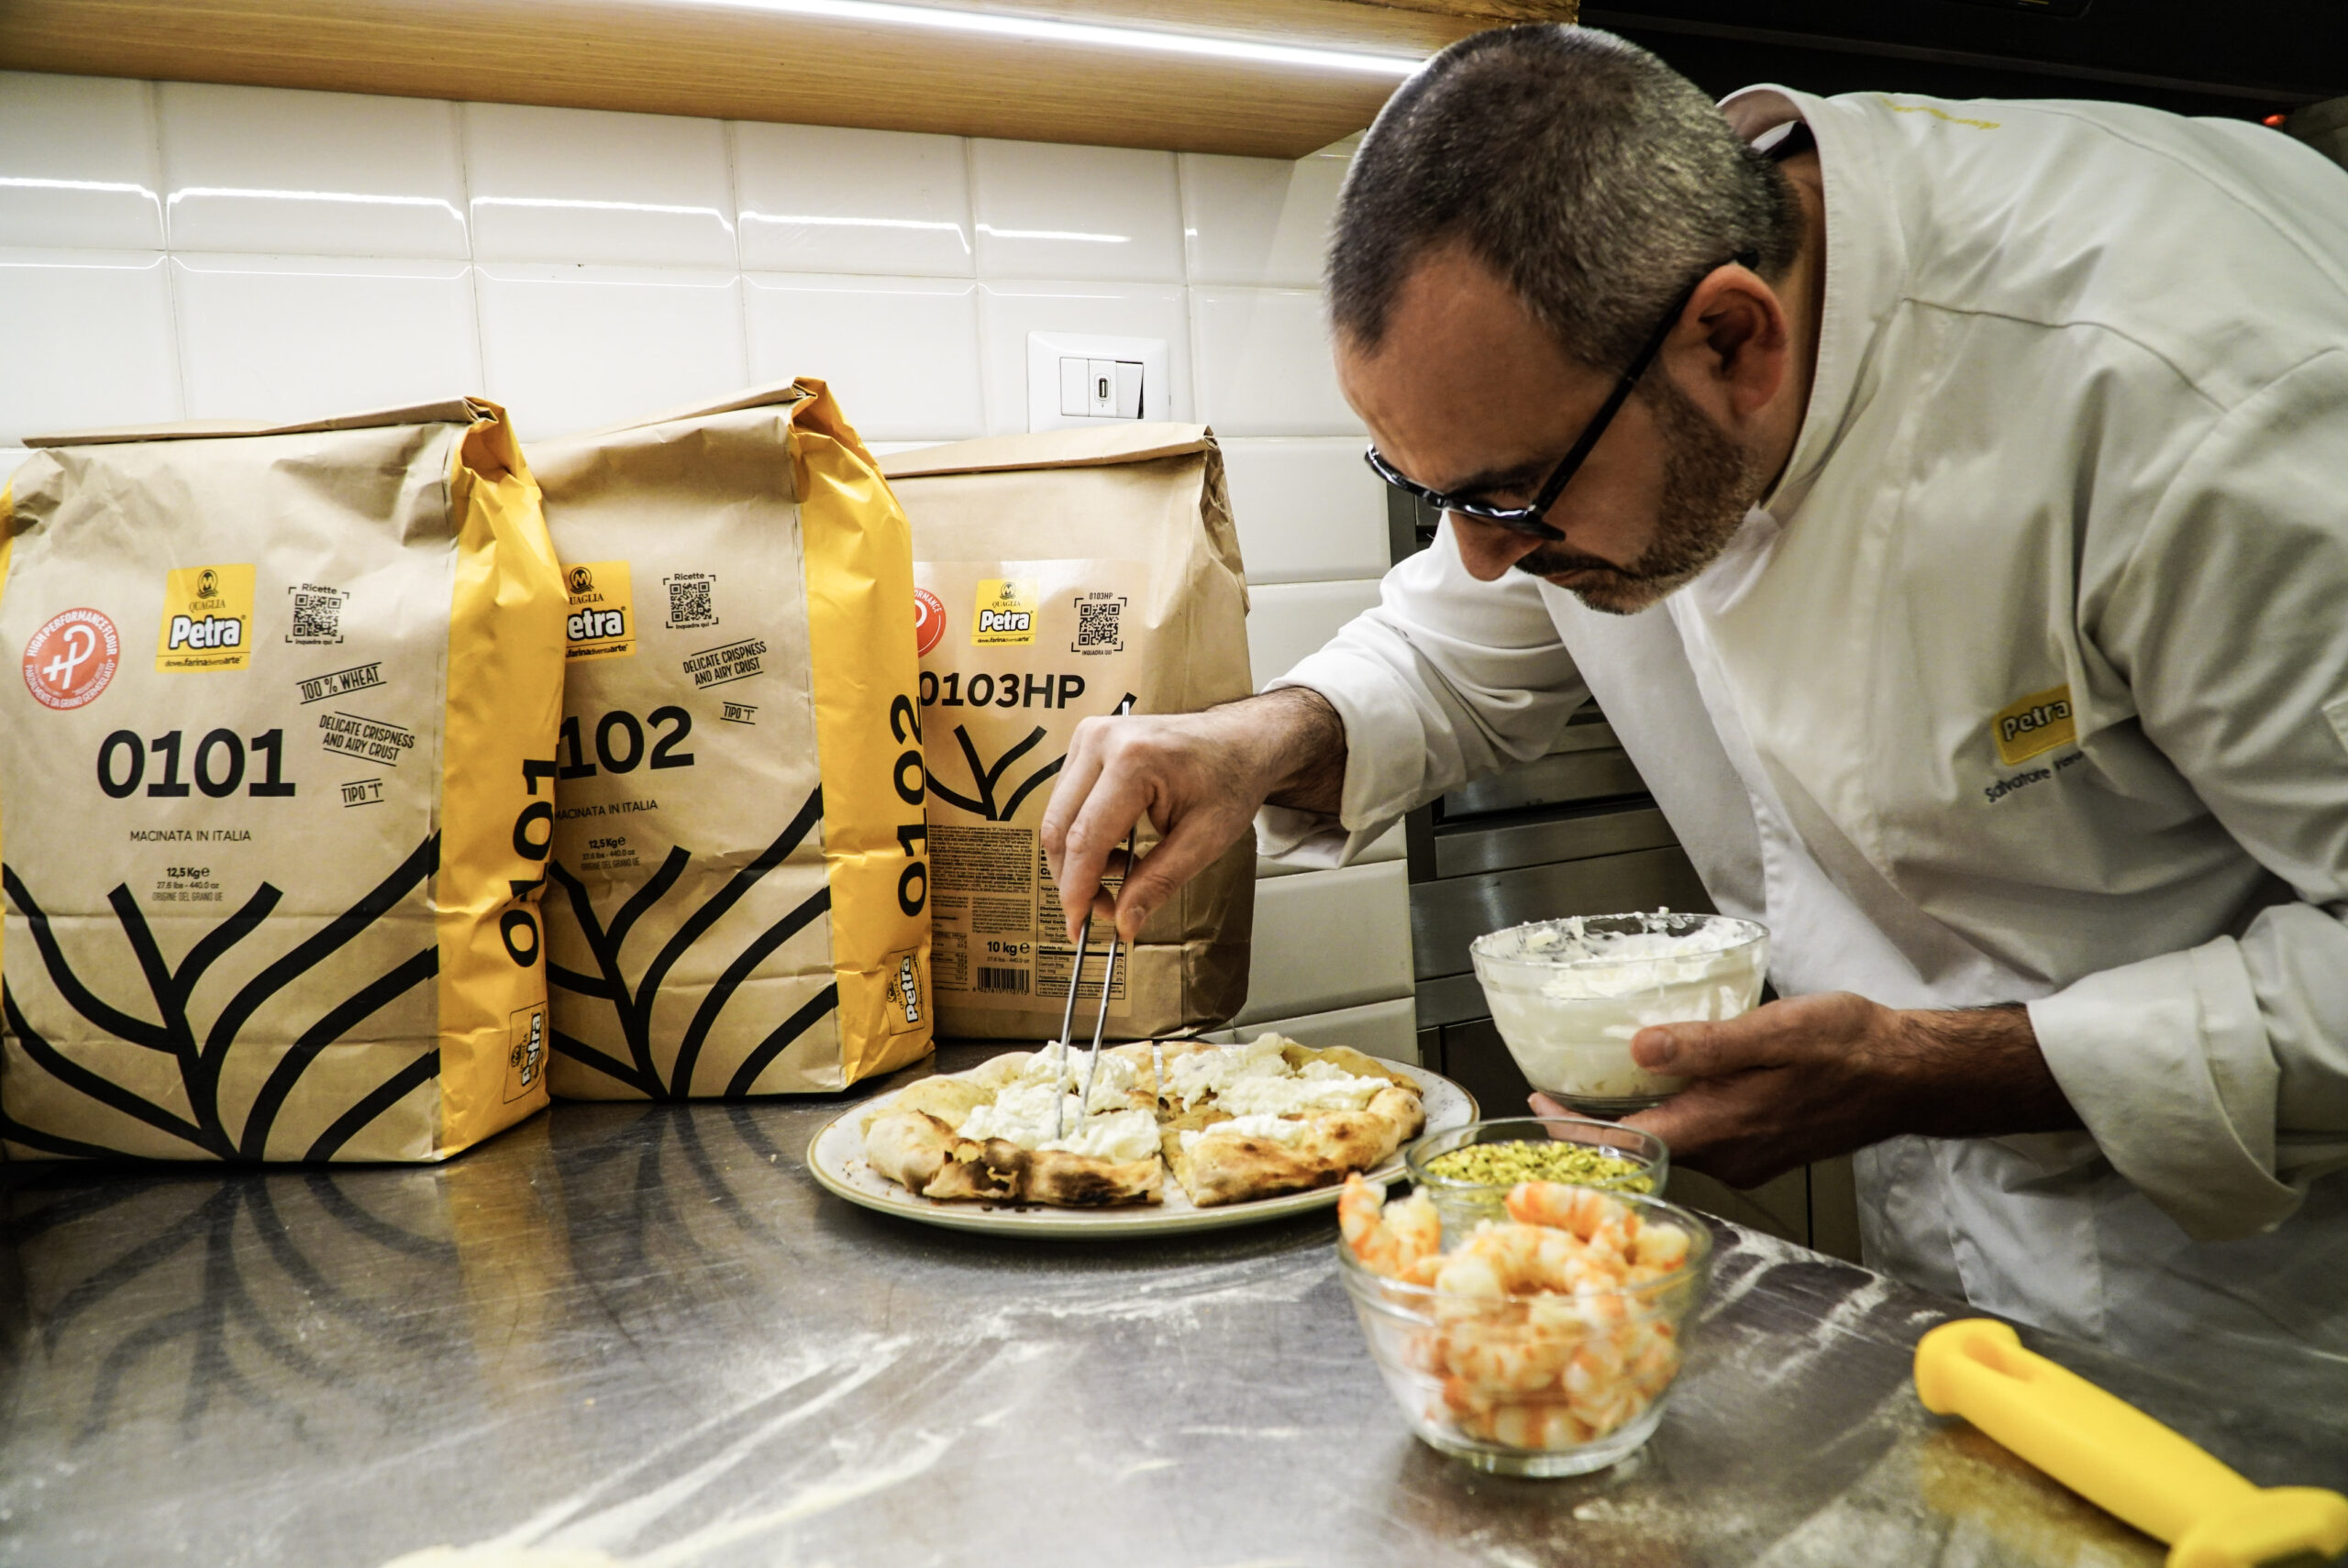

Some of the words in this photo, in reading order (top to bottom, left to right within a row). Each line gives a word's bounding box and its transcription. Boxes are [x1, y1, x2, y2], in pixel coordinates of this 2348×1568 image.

[302, 583, 338, 594] Ricette
[674, 573, 705, 581] Ricette
[189, 600, 227, 613] QUAGLIA
[570, 593, 604, 605] UAGLIA
[914, 590, 943, 613] ORMANCE
[992, 601, 1021, 609] QUAGLIA
[1089, 592, 1113, 601] 0103HP
[26, 633, 47, 657] HIGH
[42, 610, 109, 636] PERFORMANCE
[102, 624, 118, 656] FLOUR
[168, 614, 242, 650] Petra
[567, 607, 625, 641] etra
[980, 609, 1031, 633] Petra
[682, 653, 721, 674] DELICATE
[721, 641, 767, 665] CRISPNESS
[694, 669, 713, 686] AND
[714, 665, 733, 681] AIRY
[734, 657, 761, 676] CRUST
[301, 680, 322, 701] 100
[324, 677, 338, 694] %
[339, 666, 380, 690] WHEAT
[919, 670, 1086, 709] 0103HP
[724, 705, 742, 720] TIPO
[2001, 700, 2072, 742] Petra
[318, 714, 362, 736] DELICATE
[362, 724, 415, 749] CRISPNESS
[558, 705, 694, 780] 102
[323, 732, 345, 748] AND
[345, 737, 369, 753] AIRY
[369, 742, 401, 761] CRUST
[96, 728, 296, 799] 0101
[341, 785, 366, 803] TIPO
[609, 804, 620, 814] IN
[623, 800, 659, 812] ITALIA
[890, 694, 928, 918] 0102
[130, 830, 193, 841] MACINATA
[196, 830, 209, 841] IN
[213, 830, 251, 841] ITALIA
[987, 941, 1000, 953] 10
[1002, 942, 1017, 956] kg
[900, 955, 919, 1024] Petra
[522, 1012, 541, 1087] Petra
